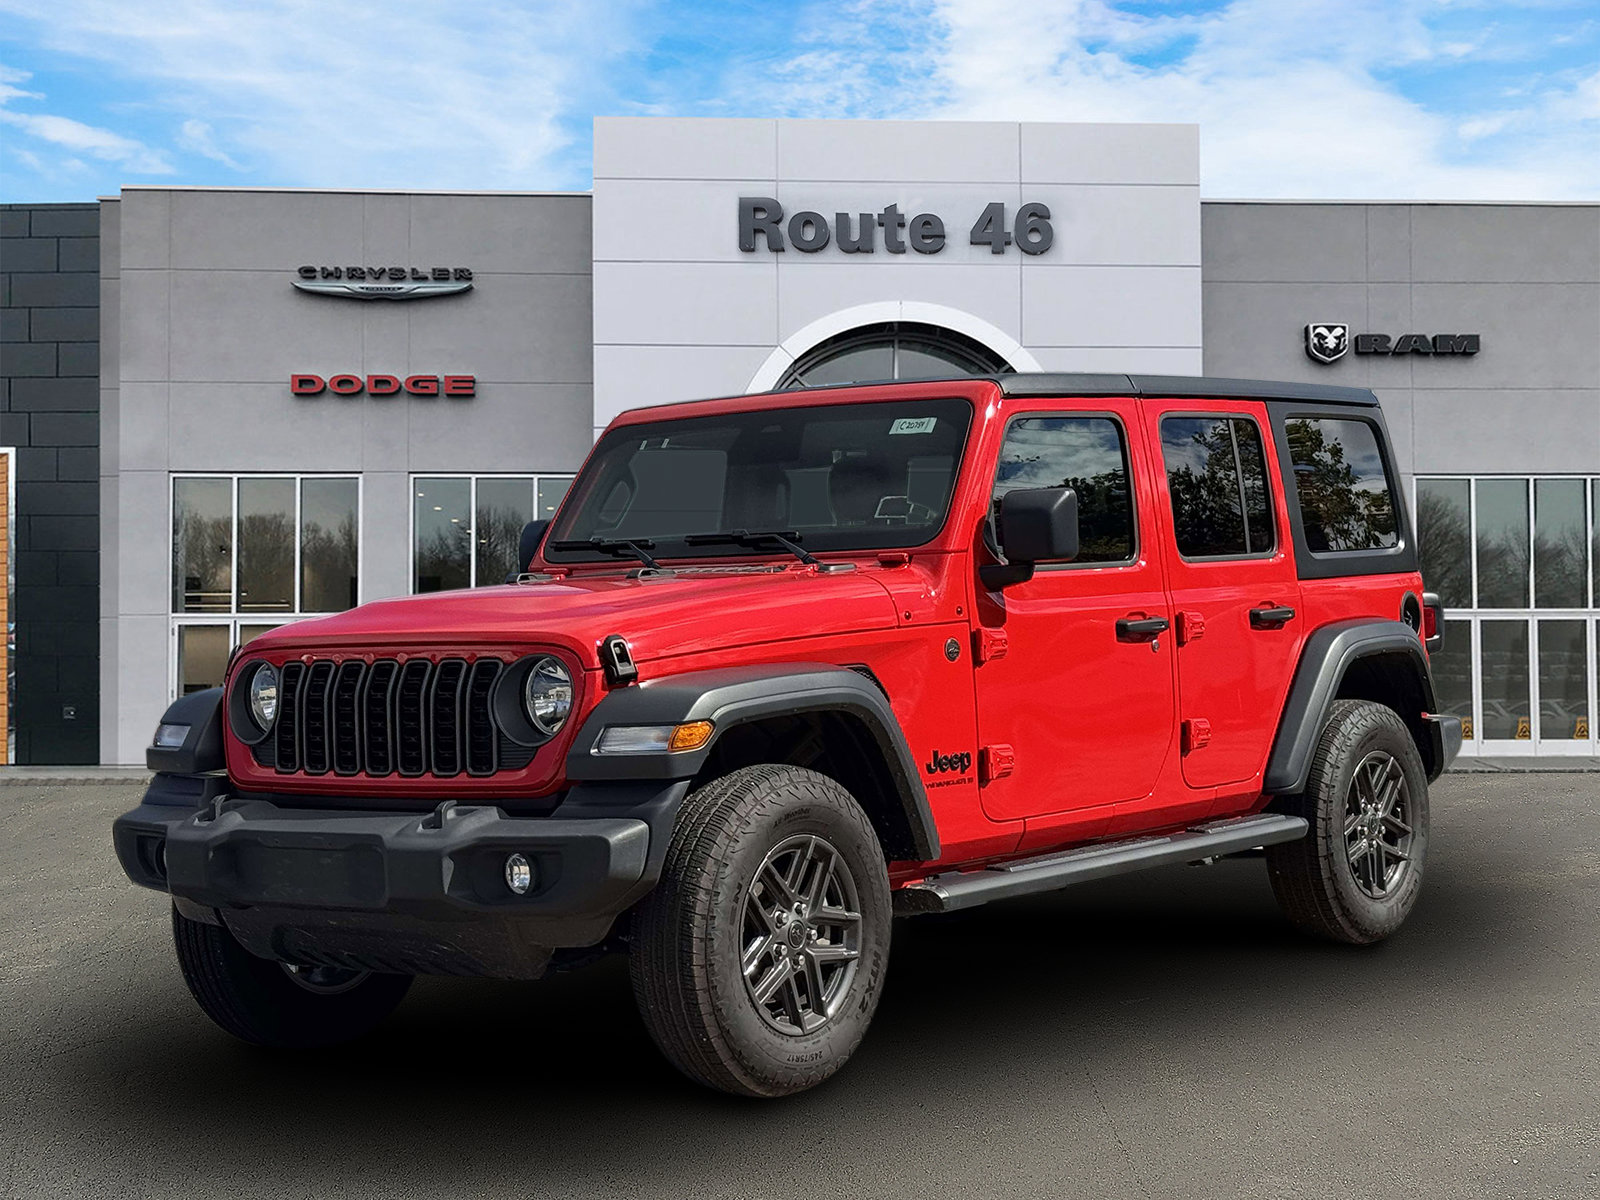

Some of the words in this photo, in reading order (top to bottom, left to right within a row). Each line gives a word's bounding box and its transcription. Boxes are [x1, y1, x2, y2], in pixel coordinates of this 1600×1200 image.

[738, 197, 946, 254] Route
[969, 202, 1055, 255] 46
[298, 266, 473, 280] CHRYSLER
[1354, 334, 1480, 355] RAM
[291, 374, 476, 397] DODGE
[925, 749, 972, 775] Jeep
